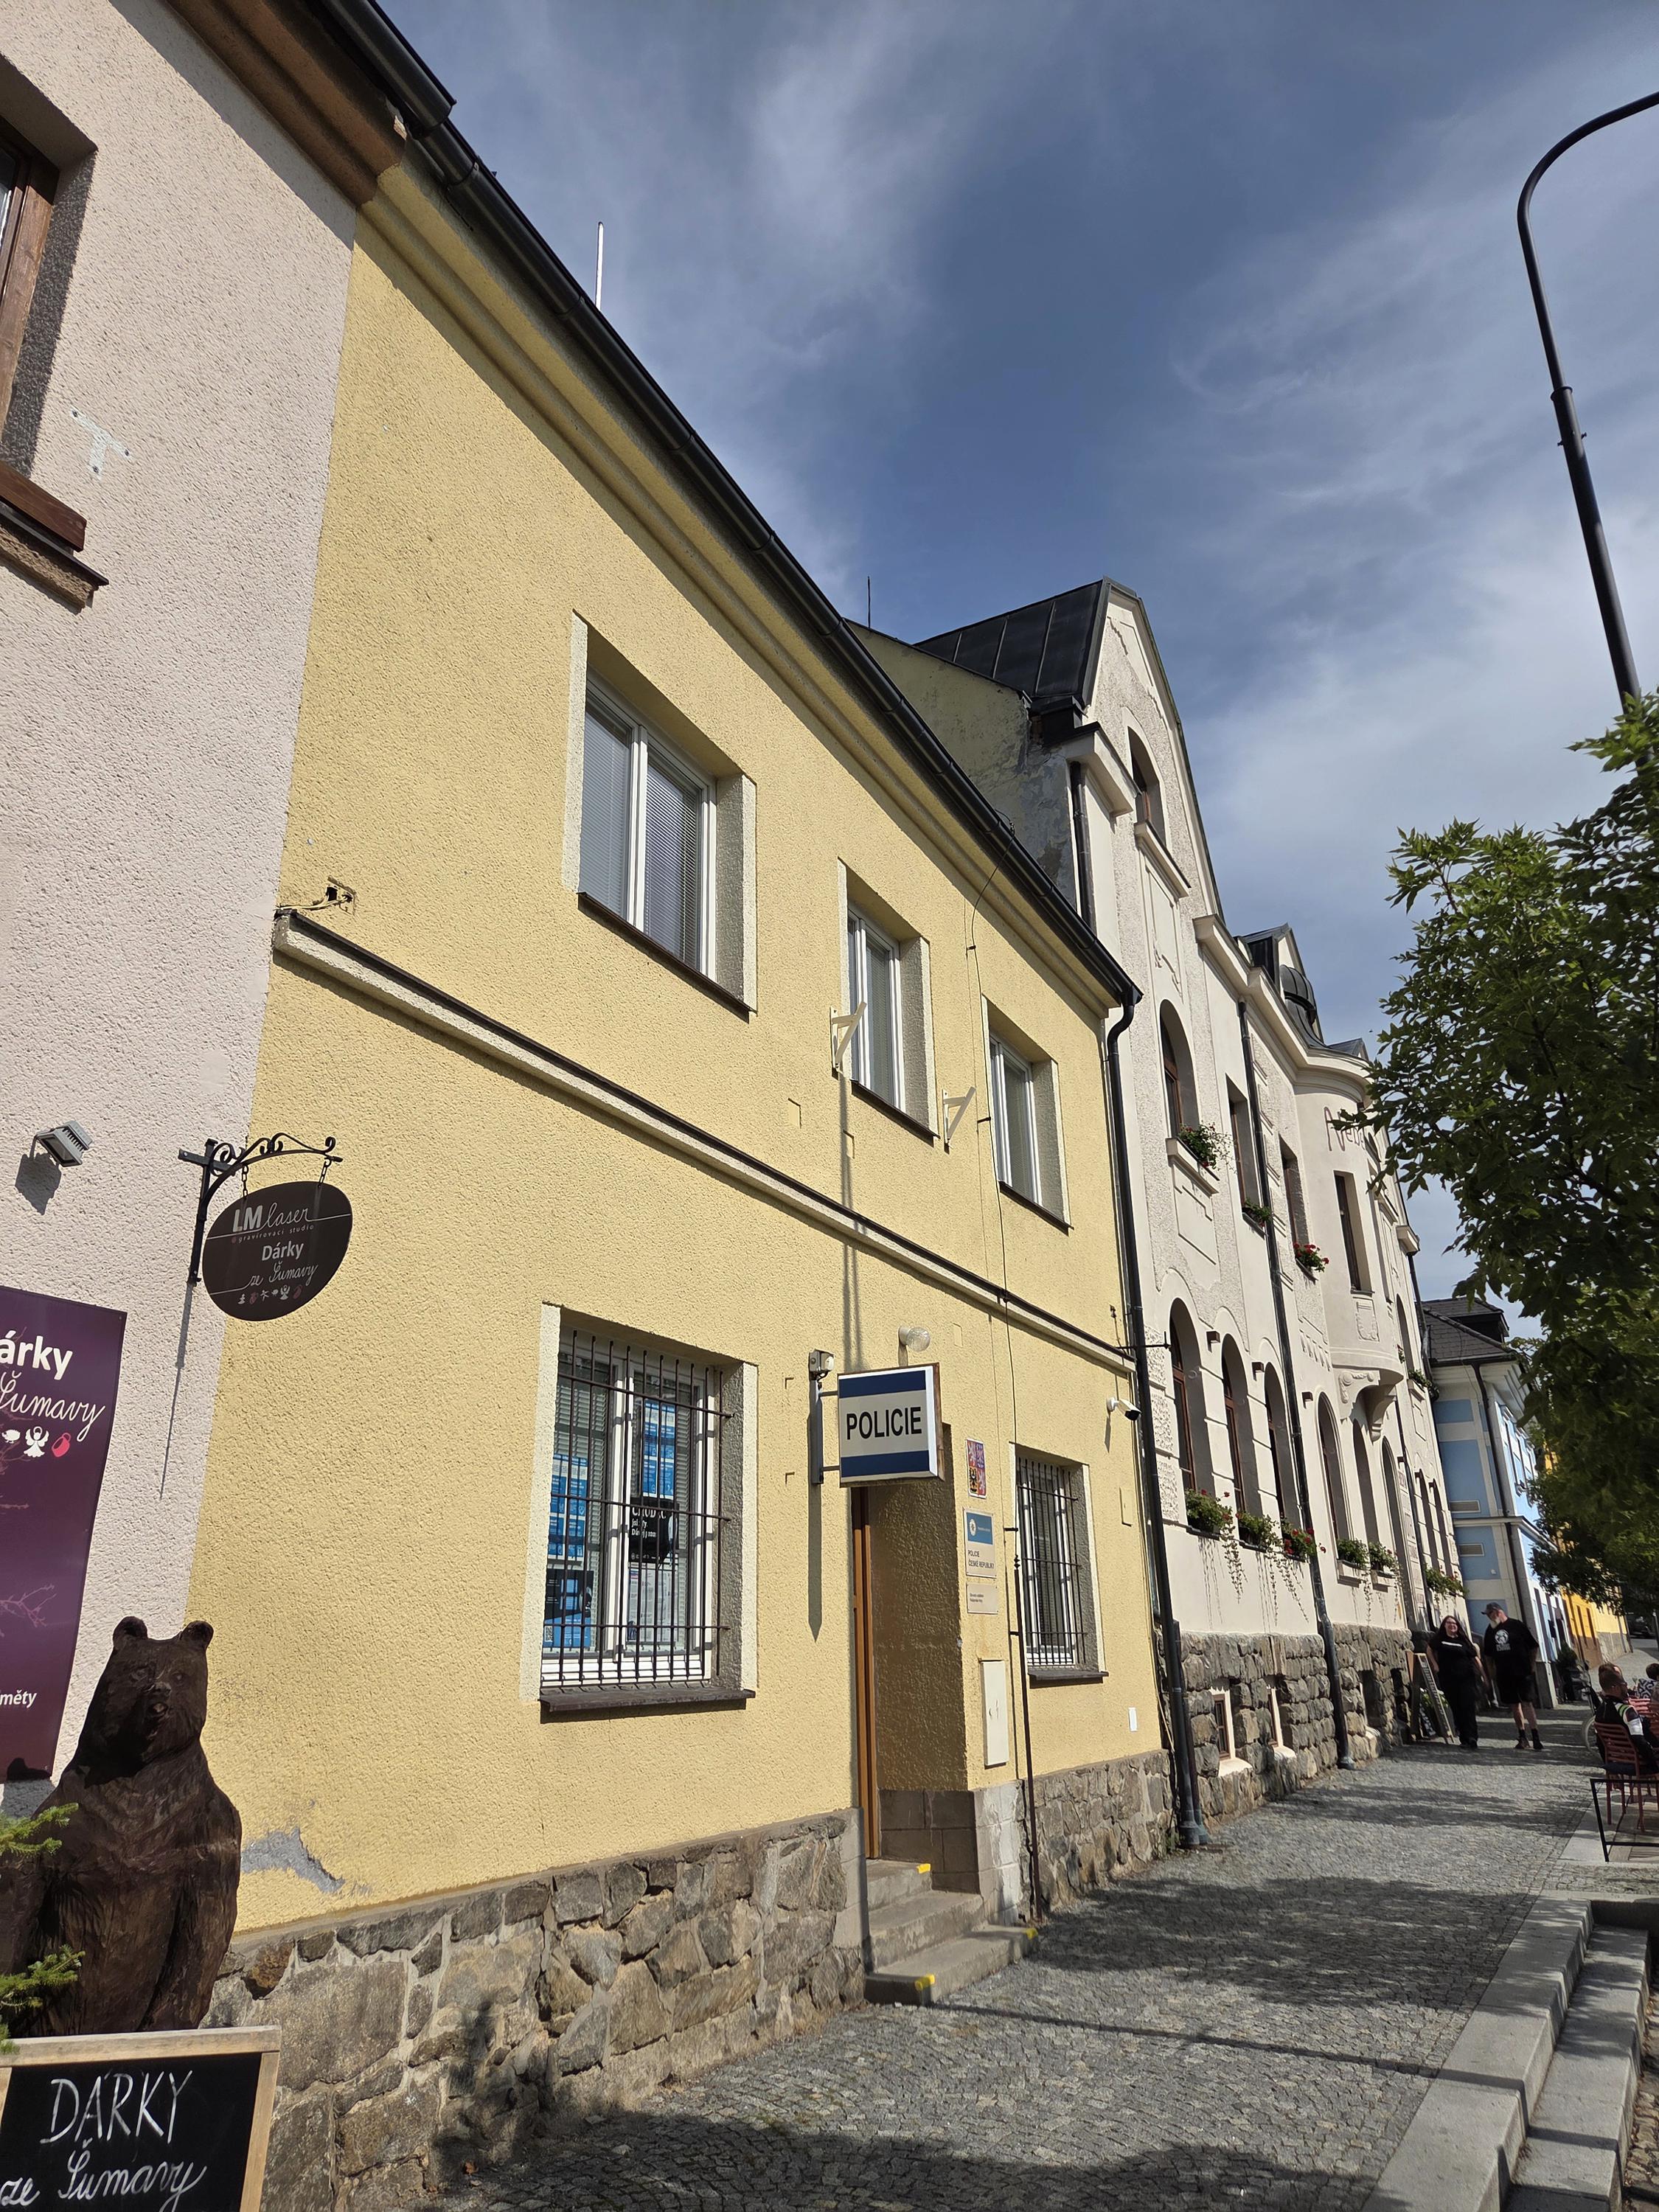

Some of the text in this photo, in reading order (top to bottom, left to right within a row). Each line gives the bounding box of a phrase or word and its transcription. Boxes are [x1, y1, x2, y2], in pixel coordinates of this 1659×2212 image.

[232, 1202, 310, 1232] LM laser
[289, 1225, 315, 1234] studio
[261, 1240, 305, 1261] Dárky
[248, 1261, 319, 1287] ze Šumavy
[0, 1370, 106, 1442] Šumavy
[846, 1406, 922, 1440] POLICIE
[0, 2138, 208, 2212] ze Šumavy
